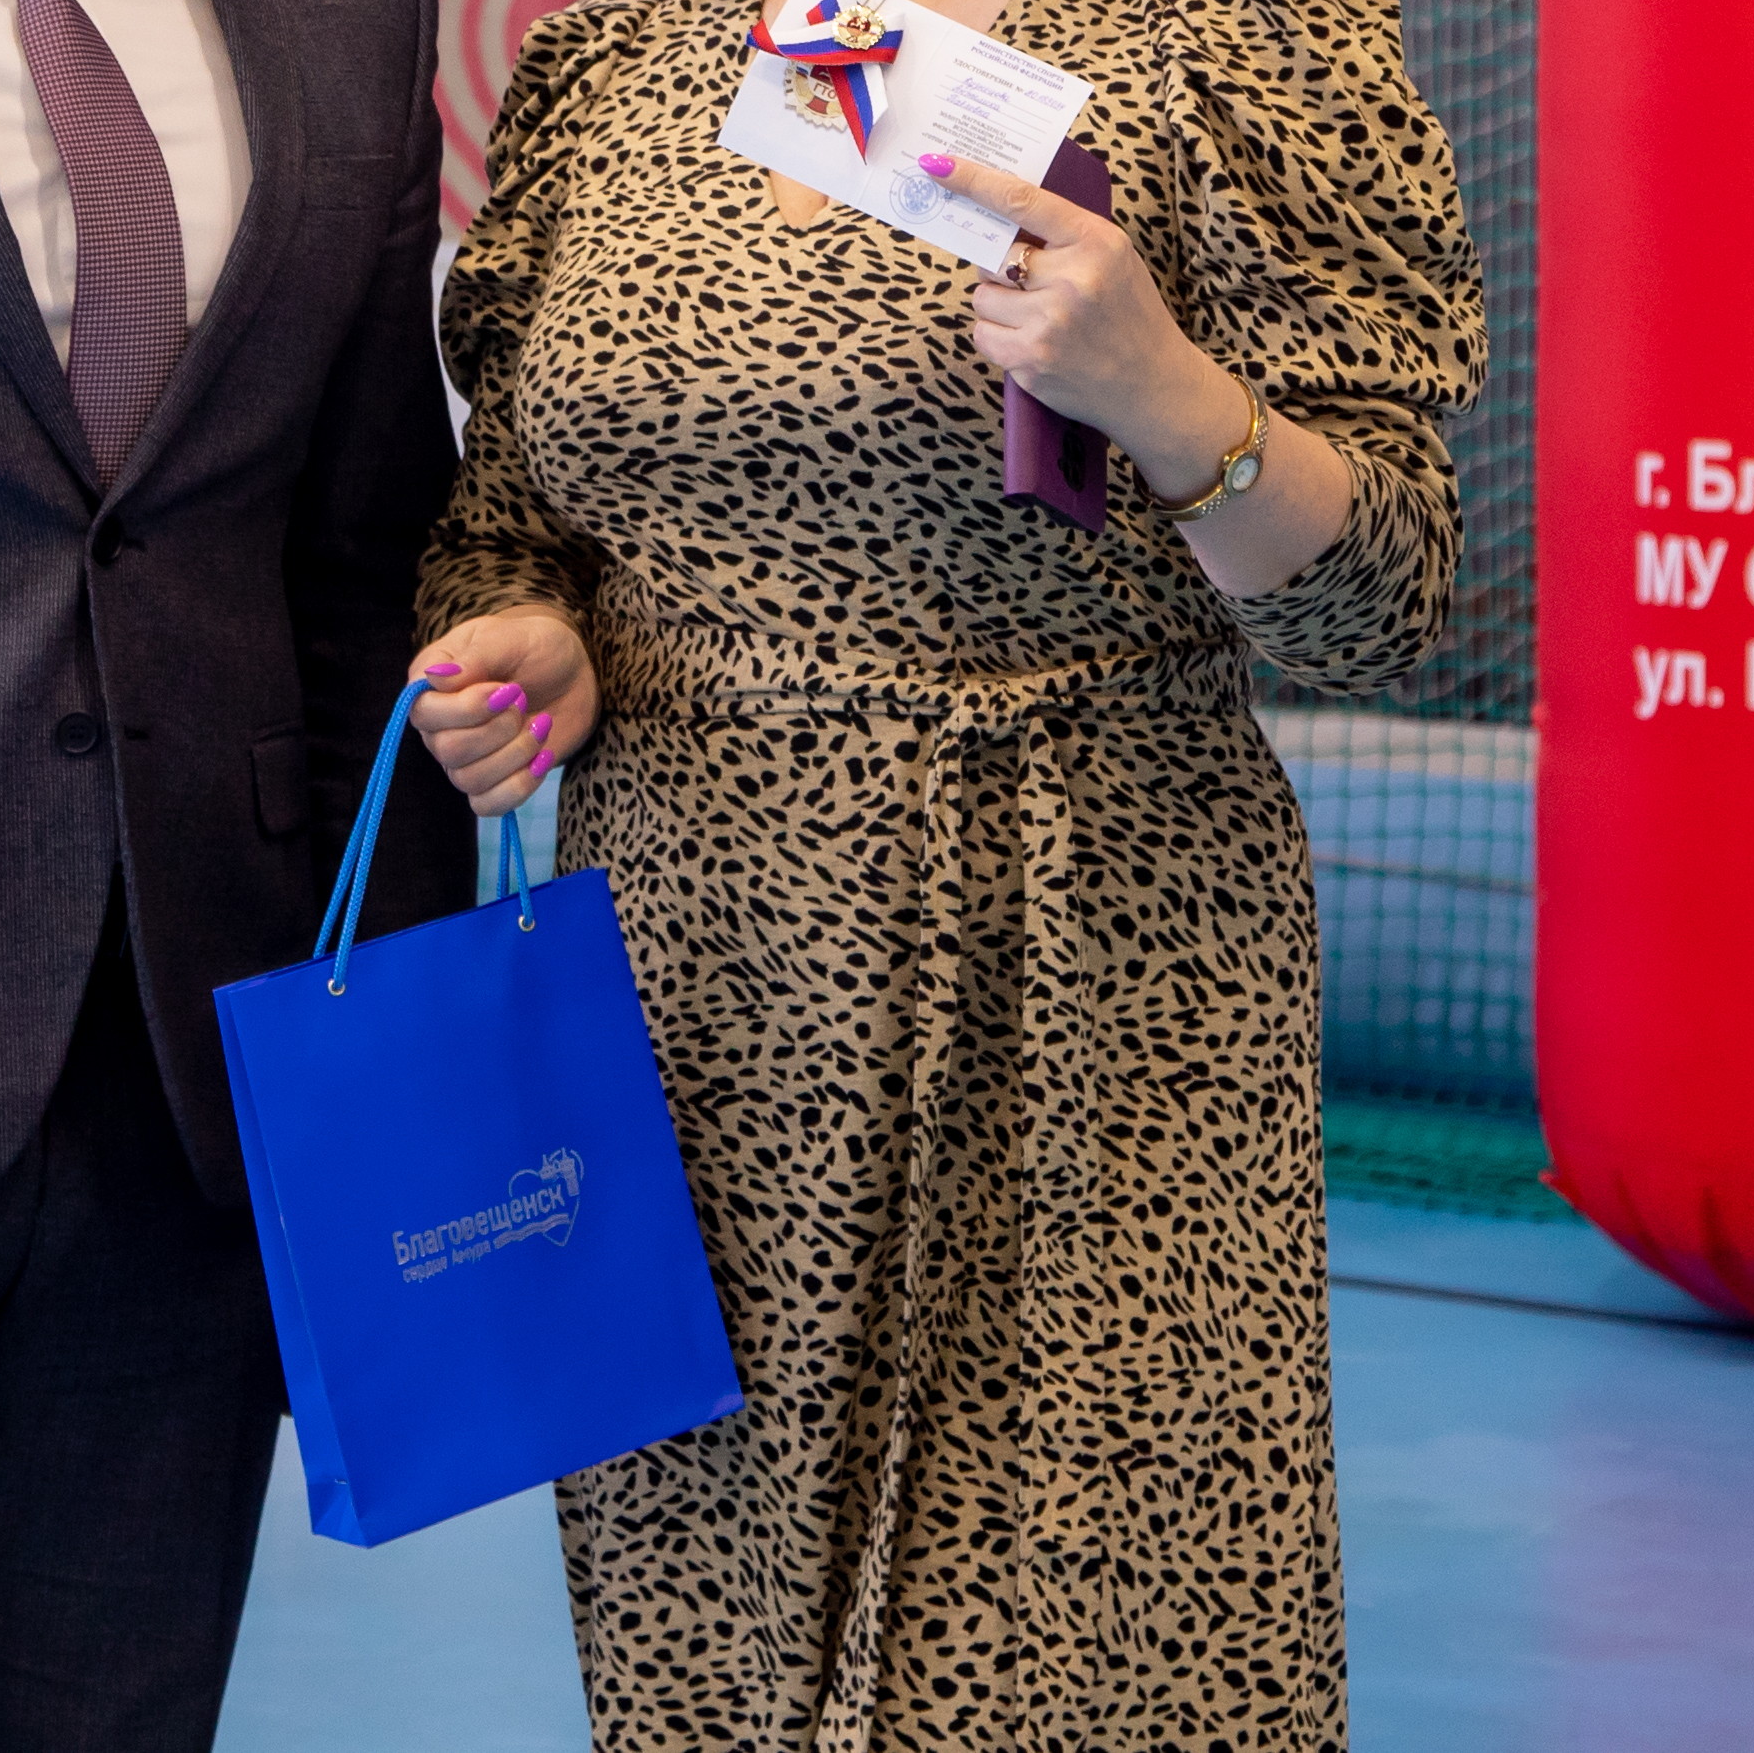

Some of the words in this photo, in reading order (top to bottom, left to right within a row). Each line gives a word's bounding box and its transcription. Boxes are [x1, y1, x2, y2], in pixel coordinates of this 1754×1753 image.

[952, 57, 1013, 89] УДОСТОВЕРЕНИЕ
[970, 44, 1019, 71] РОССИЙСКОЙ
[1019, 67, 1063, 92] ФЕДЕРАЦИИ
[977, 39, 1036, 70] МИНИСТЕРСТВО
[1036, 66, 1065, 83] СПОРТА
[813, 82, 837, 100] ГТО
[1635, 451, 1672, 509] г.
[1635, 530, 1729, 610] МУ
[1633, 645, 1725, 721] ул.
[392, 1184, 565, 1265] Благовещенск
